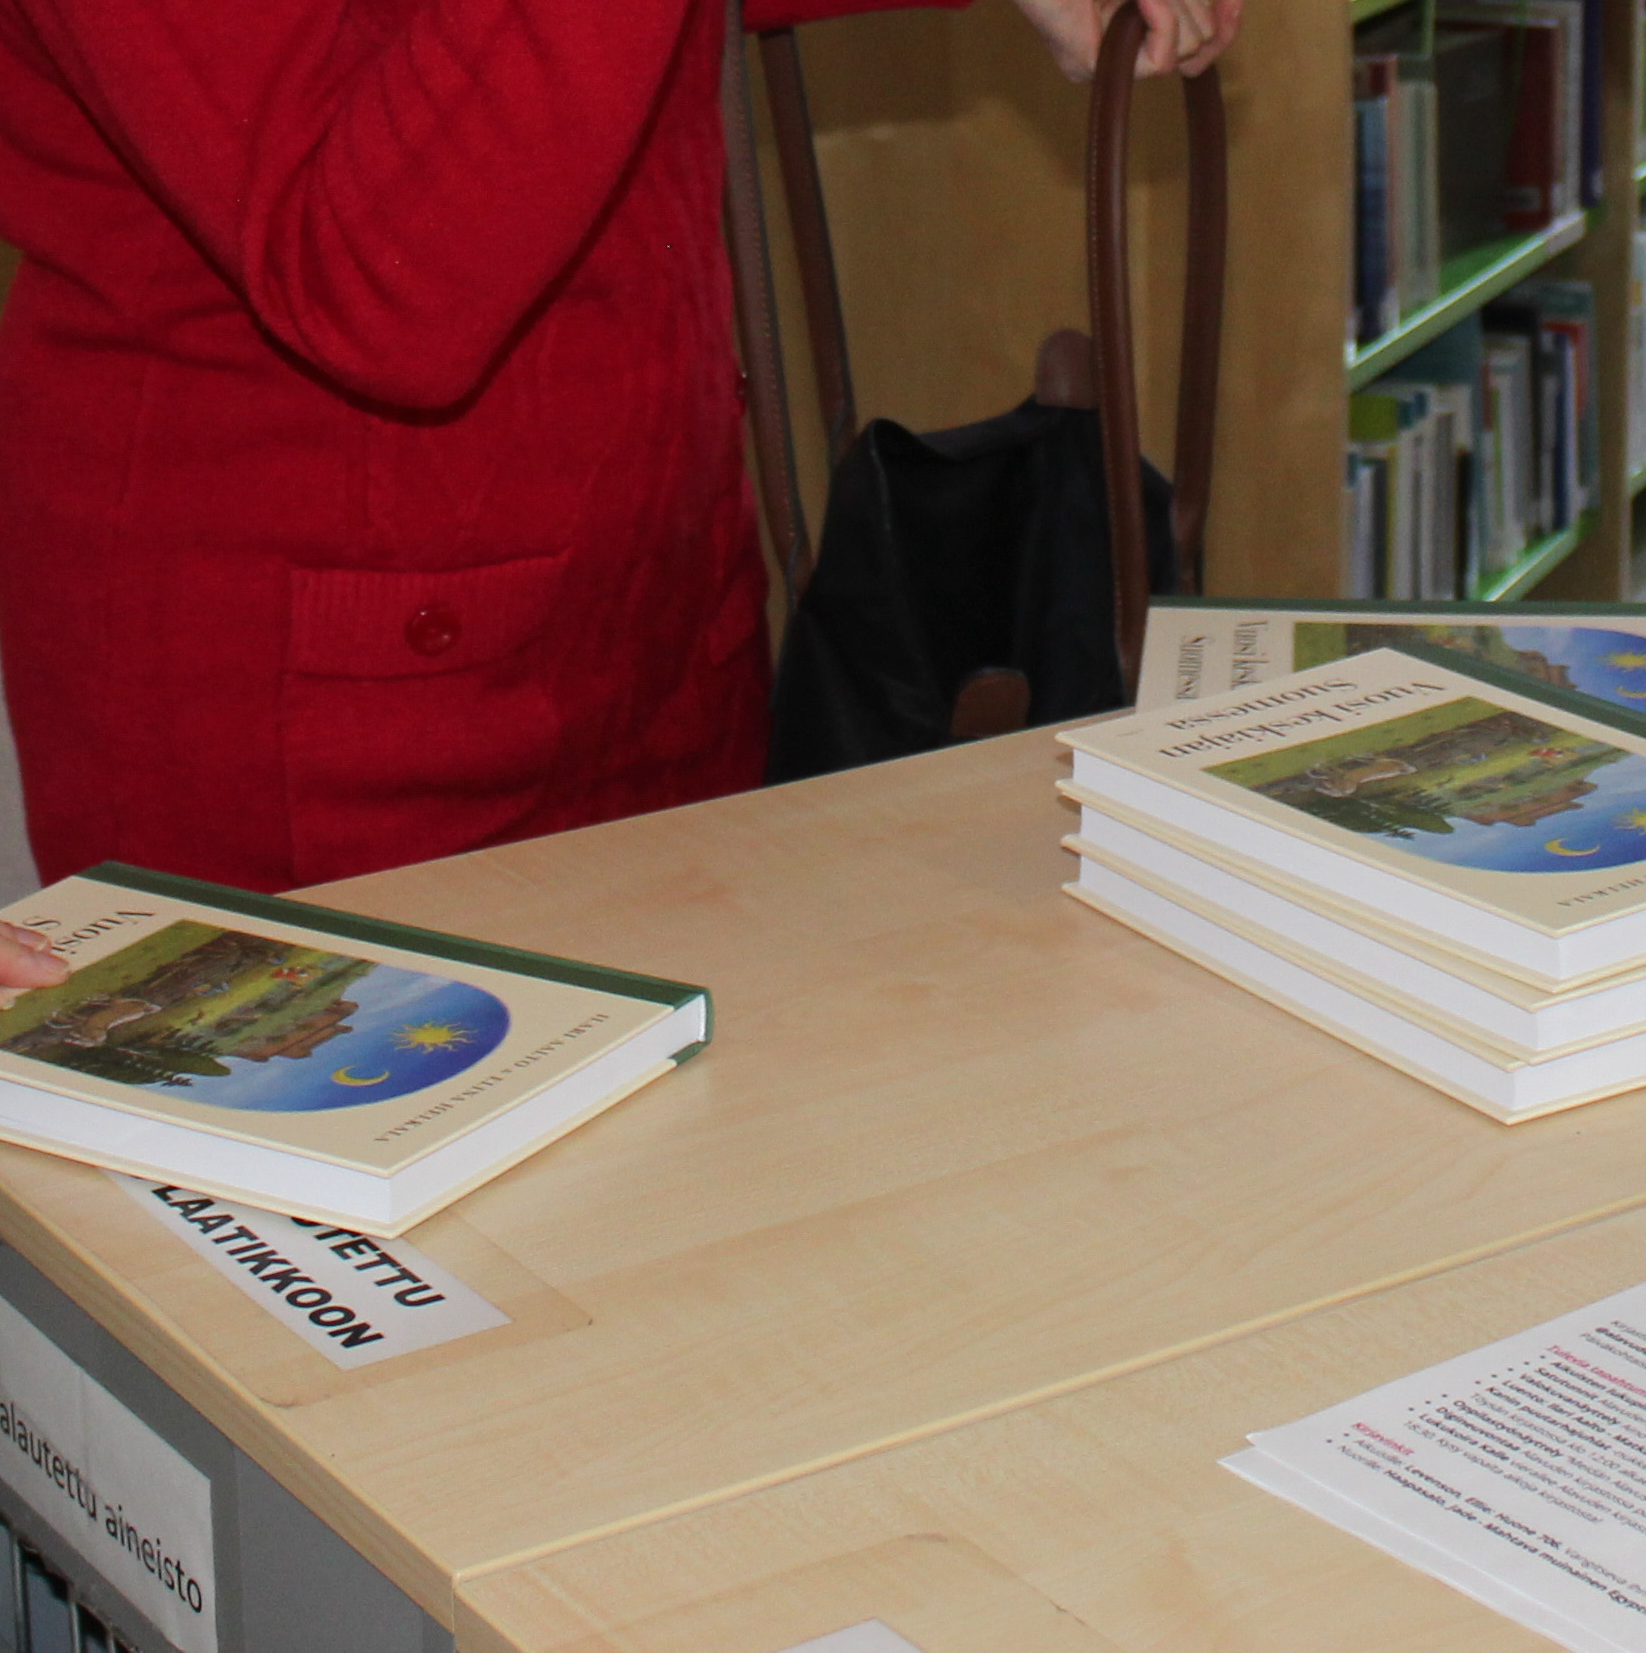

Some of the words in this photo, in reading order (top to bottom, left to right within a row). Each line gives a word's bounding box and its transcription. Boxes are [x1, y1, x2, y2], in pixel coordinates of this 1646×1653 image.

[1166, 679, 1358, 730] Suomessa
[1345, 681, 1445, 714] Vuosi
[1159, 710, 1344, 759] keskiajan
[51, 910, 156, 954] Vuosi
[151, 1184, 385, 1349] LAATIKKOON
[104, 1501, 205, 1614] aineisto
